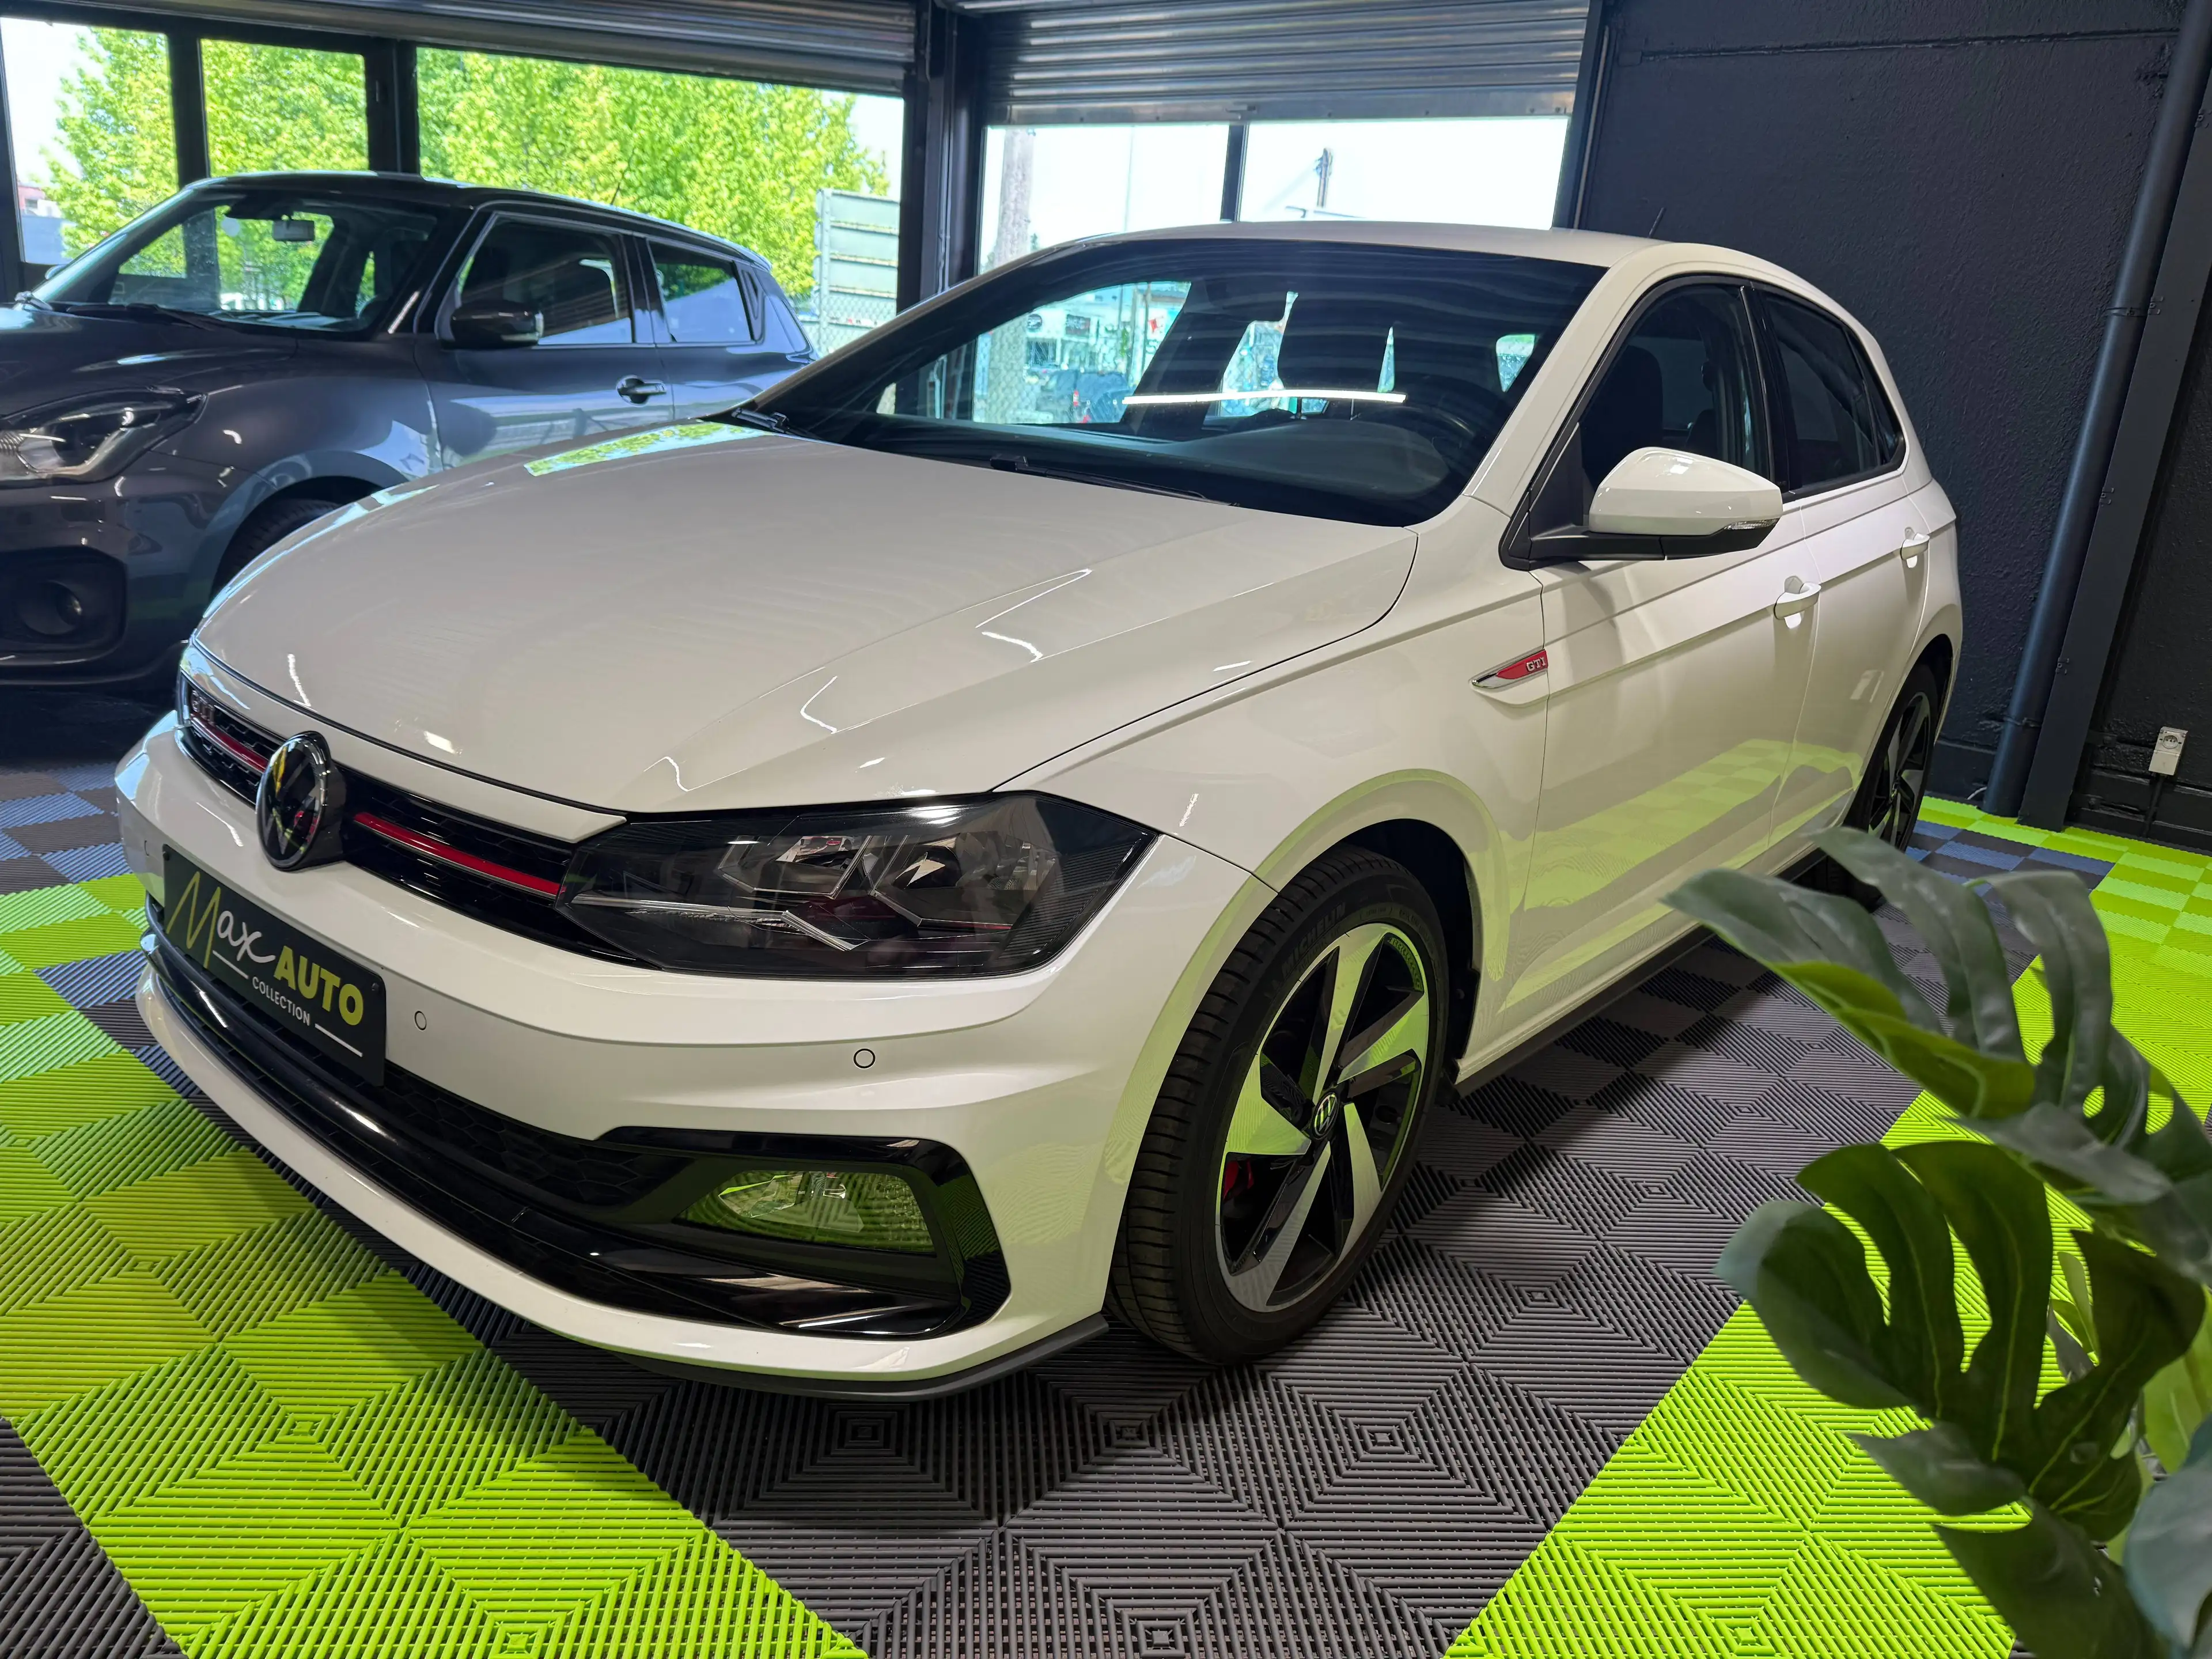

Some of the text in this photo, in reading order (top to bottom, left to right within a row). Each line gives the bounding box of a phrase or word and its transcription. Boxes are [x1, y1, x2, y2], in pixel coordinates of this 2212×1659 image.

[1527, 657, 1547, 672] GTI
[166, 871, 364, 1026] Max AUTO
[1281, 901, 1346, 978] MICHELIN
[252, 976, 311, 1027] COLLECTION
